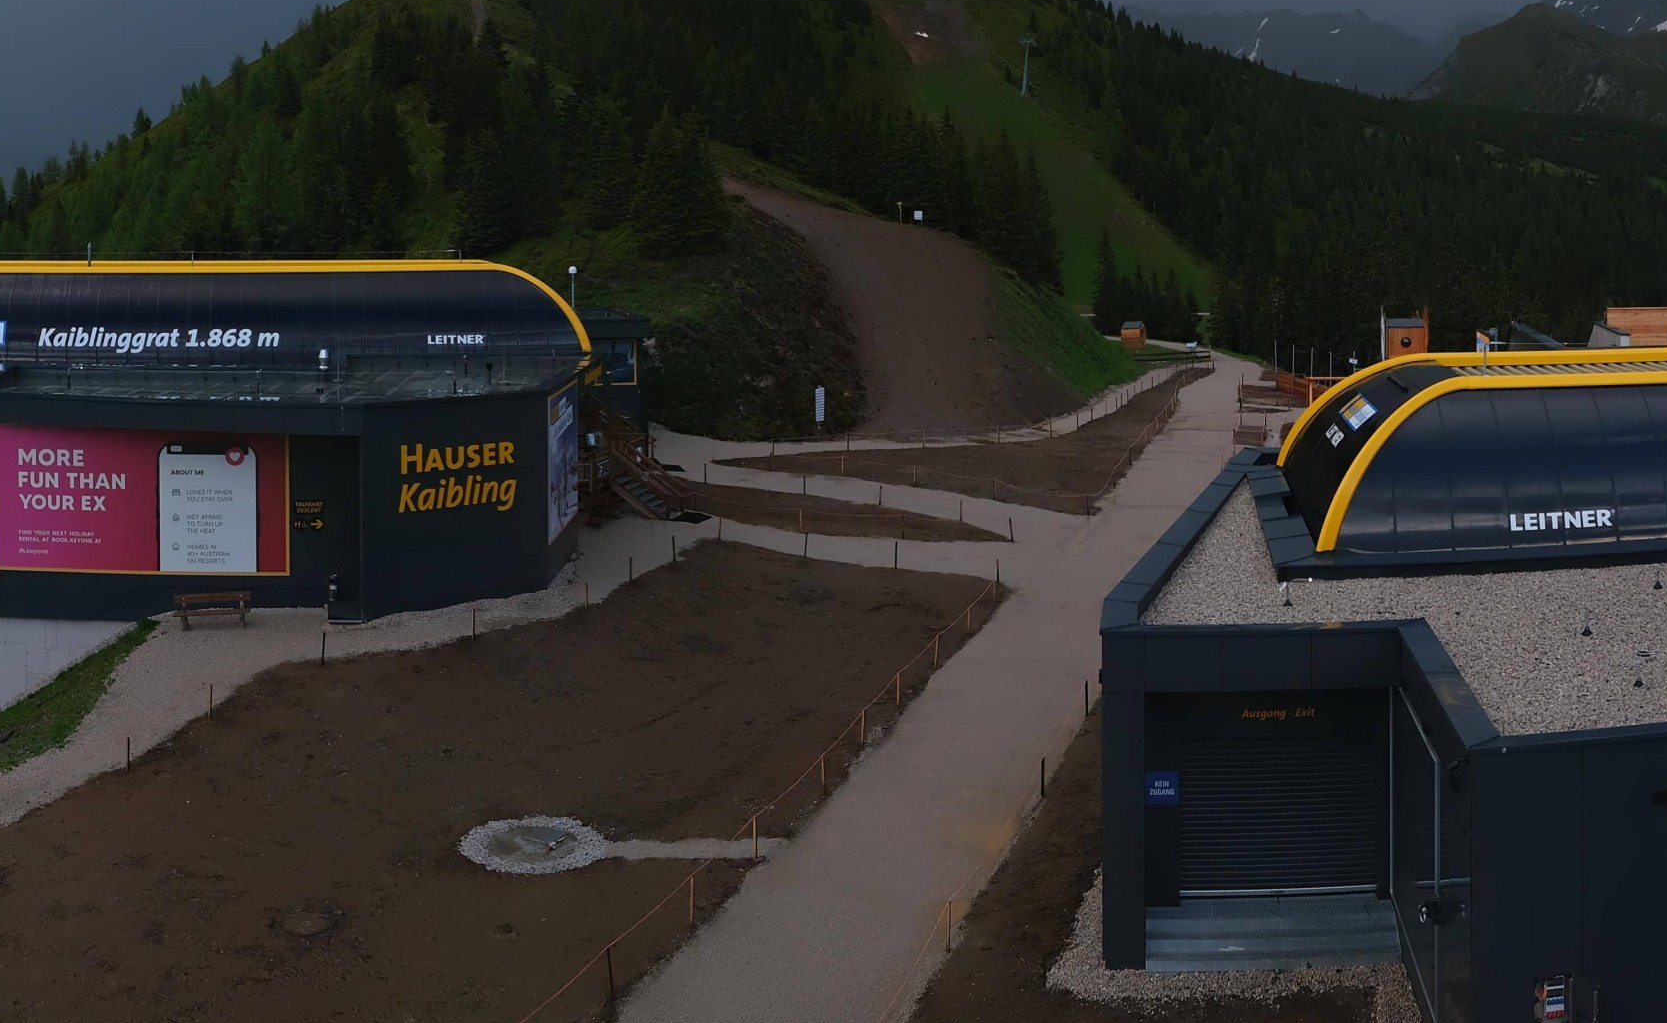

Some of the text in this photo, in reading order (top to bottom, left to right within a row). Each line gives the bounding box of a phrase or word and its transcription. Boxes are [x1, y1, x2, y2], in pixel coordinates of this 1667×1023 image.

[38, 327, 280, 353] Kaiblinggrat 1.868 m
[427, 334, 484, 345] LEITNER
[17, 448, 85, 467] MORE
[400, 441, 515, 475] HAUSER
[18, 471, 126, 490] FUN THAN
[19, 493, 106, 512] YOUR EX
[398, 475, 517, 513] Kaibling
[1509, 509, 1613, 531] LEITNER
[1241, 708, 1287, 721] Ausgang
[1295, 707, 1316, 717] Exit
[1149, 788, 1175, 796] ZUGANG
[1154, 780, 1170, 788] KEIN
